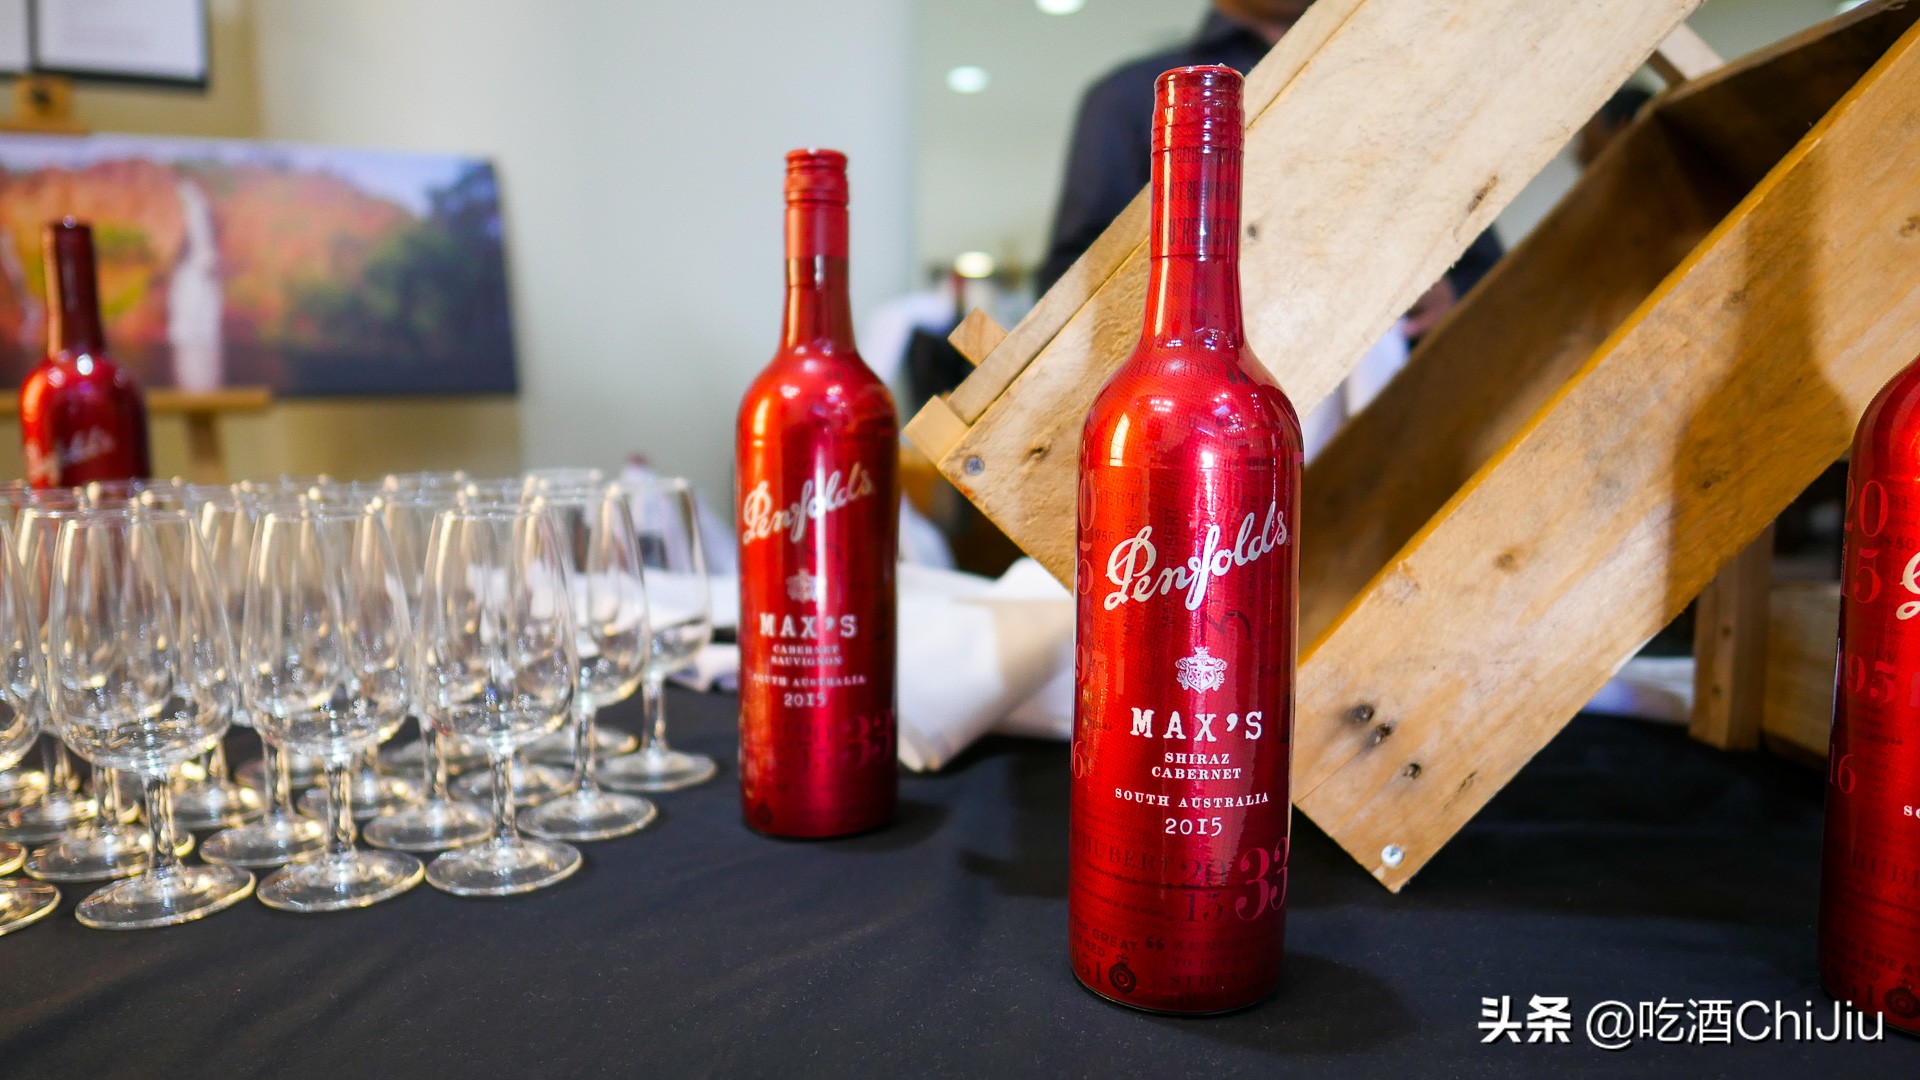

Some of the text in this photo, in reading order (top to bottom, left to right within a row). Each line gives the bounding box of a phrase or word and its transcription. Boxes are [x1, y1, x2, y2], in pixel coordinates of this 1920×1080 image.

[742, 461, 874, 545] Penfolds
[1103, 502, 1288, 612] Penfolds
[759, 613, 858, 638] MAX'S
[772, 643, 840, 655] CABERNET
[770, 655, 843, 667] SAUVIGNON
[793, 674, 866, 688] AUSTRALIA
[783, 691, 828, 708] 2015
[1130, 707, 1263, 742] MAX'S
[1164, 751, 1231, 765] SHIRAZ
[1151, 766, 1242, 780] CABERNET
[1115, 787, 1270, 809] SOUTH AUSTRALIA
[1164, 817, 1223, 837] 2015
